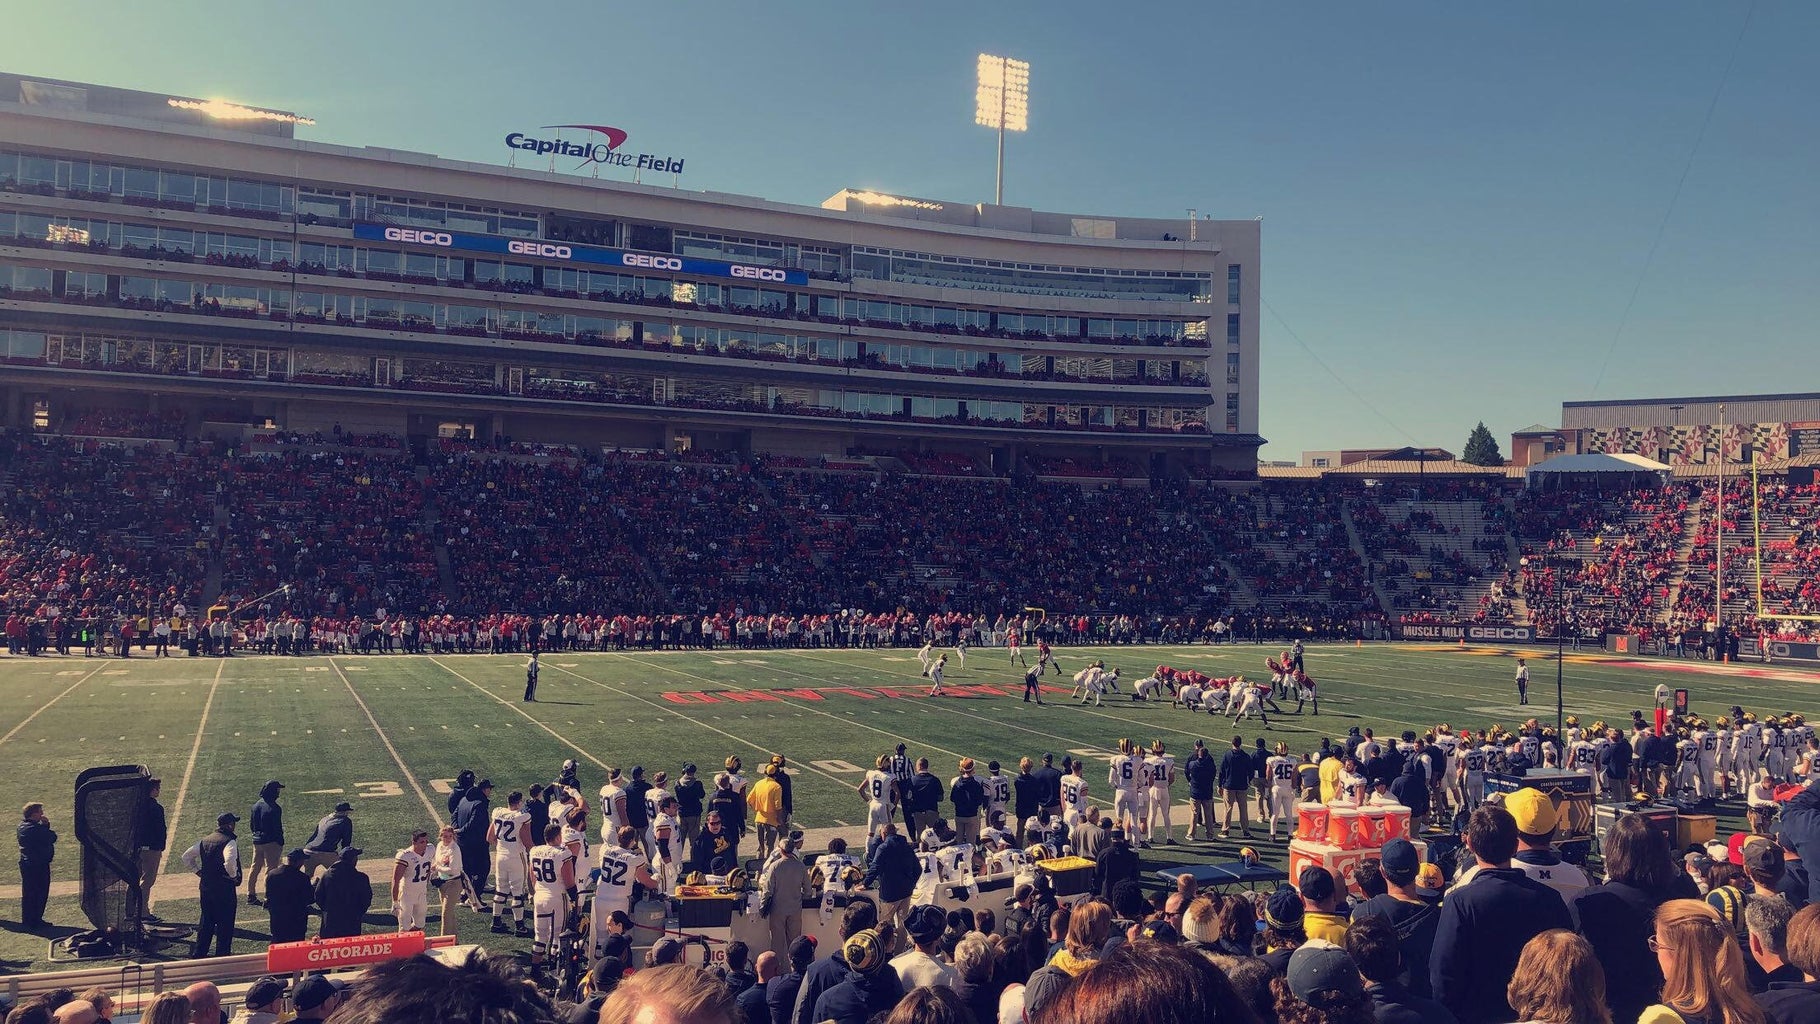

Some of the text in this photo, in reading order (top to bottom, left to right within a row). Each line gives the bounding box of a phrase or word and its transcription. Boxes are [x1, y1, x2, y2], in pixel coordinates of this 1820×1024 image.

[505, 132, 685, 174] Capital One Field
[384, 226, 453, 247] GEICO
[507, 239, 572, 260] GEICO
[622, 252, 682, 272] GEICO
[730, 264, 787, 283] GEICO
[1402, 625, 1465, 638] MUSCLE MILK
[1469, 627, 1530, 639] GEICO
[1122, 762, 1133, 780] 6
[1274, 764, 1293, 780] 46
[1467, 756, 1483, 772] 32
[872, 779, 882, 799] 8
[994, 782, 1007, 802] 19
[494, 819, 517, 843] 72
[412, 861, 431, 883] 13
[532, 857, 557, 884] 58
[601, 856, 628, 887] 52
[1539, 870, 1551, 880] M
[307, 943, 392, 962] GATORADE
